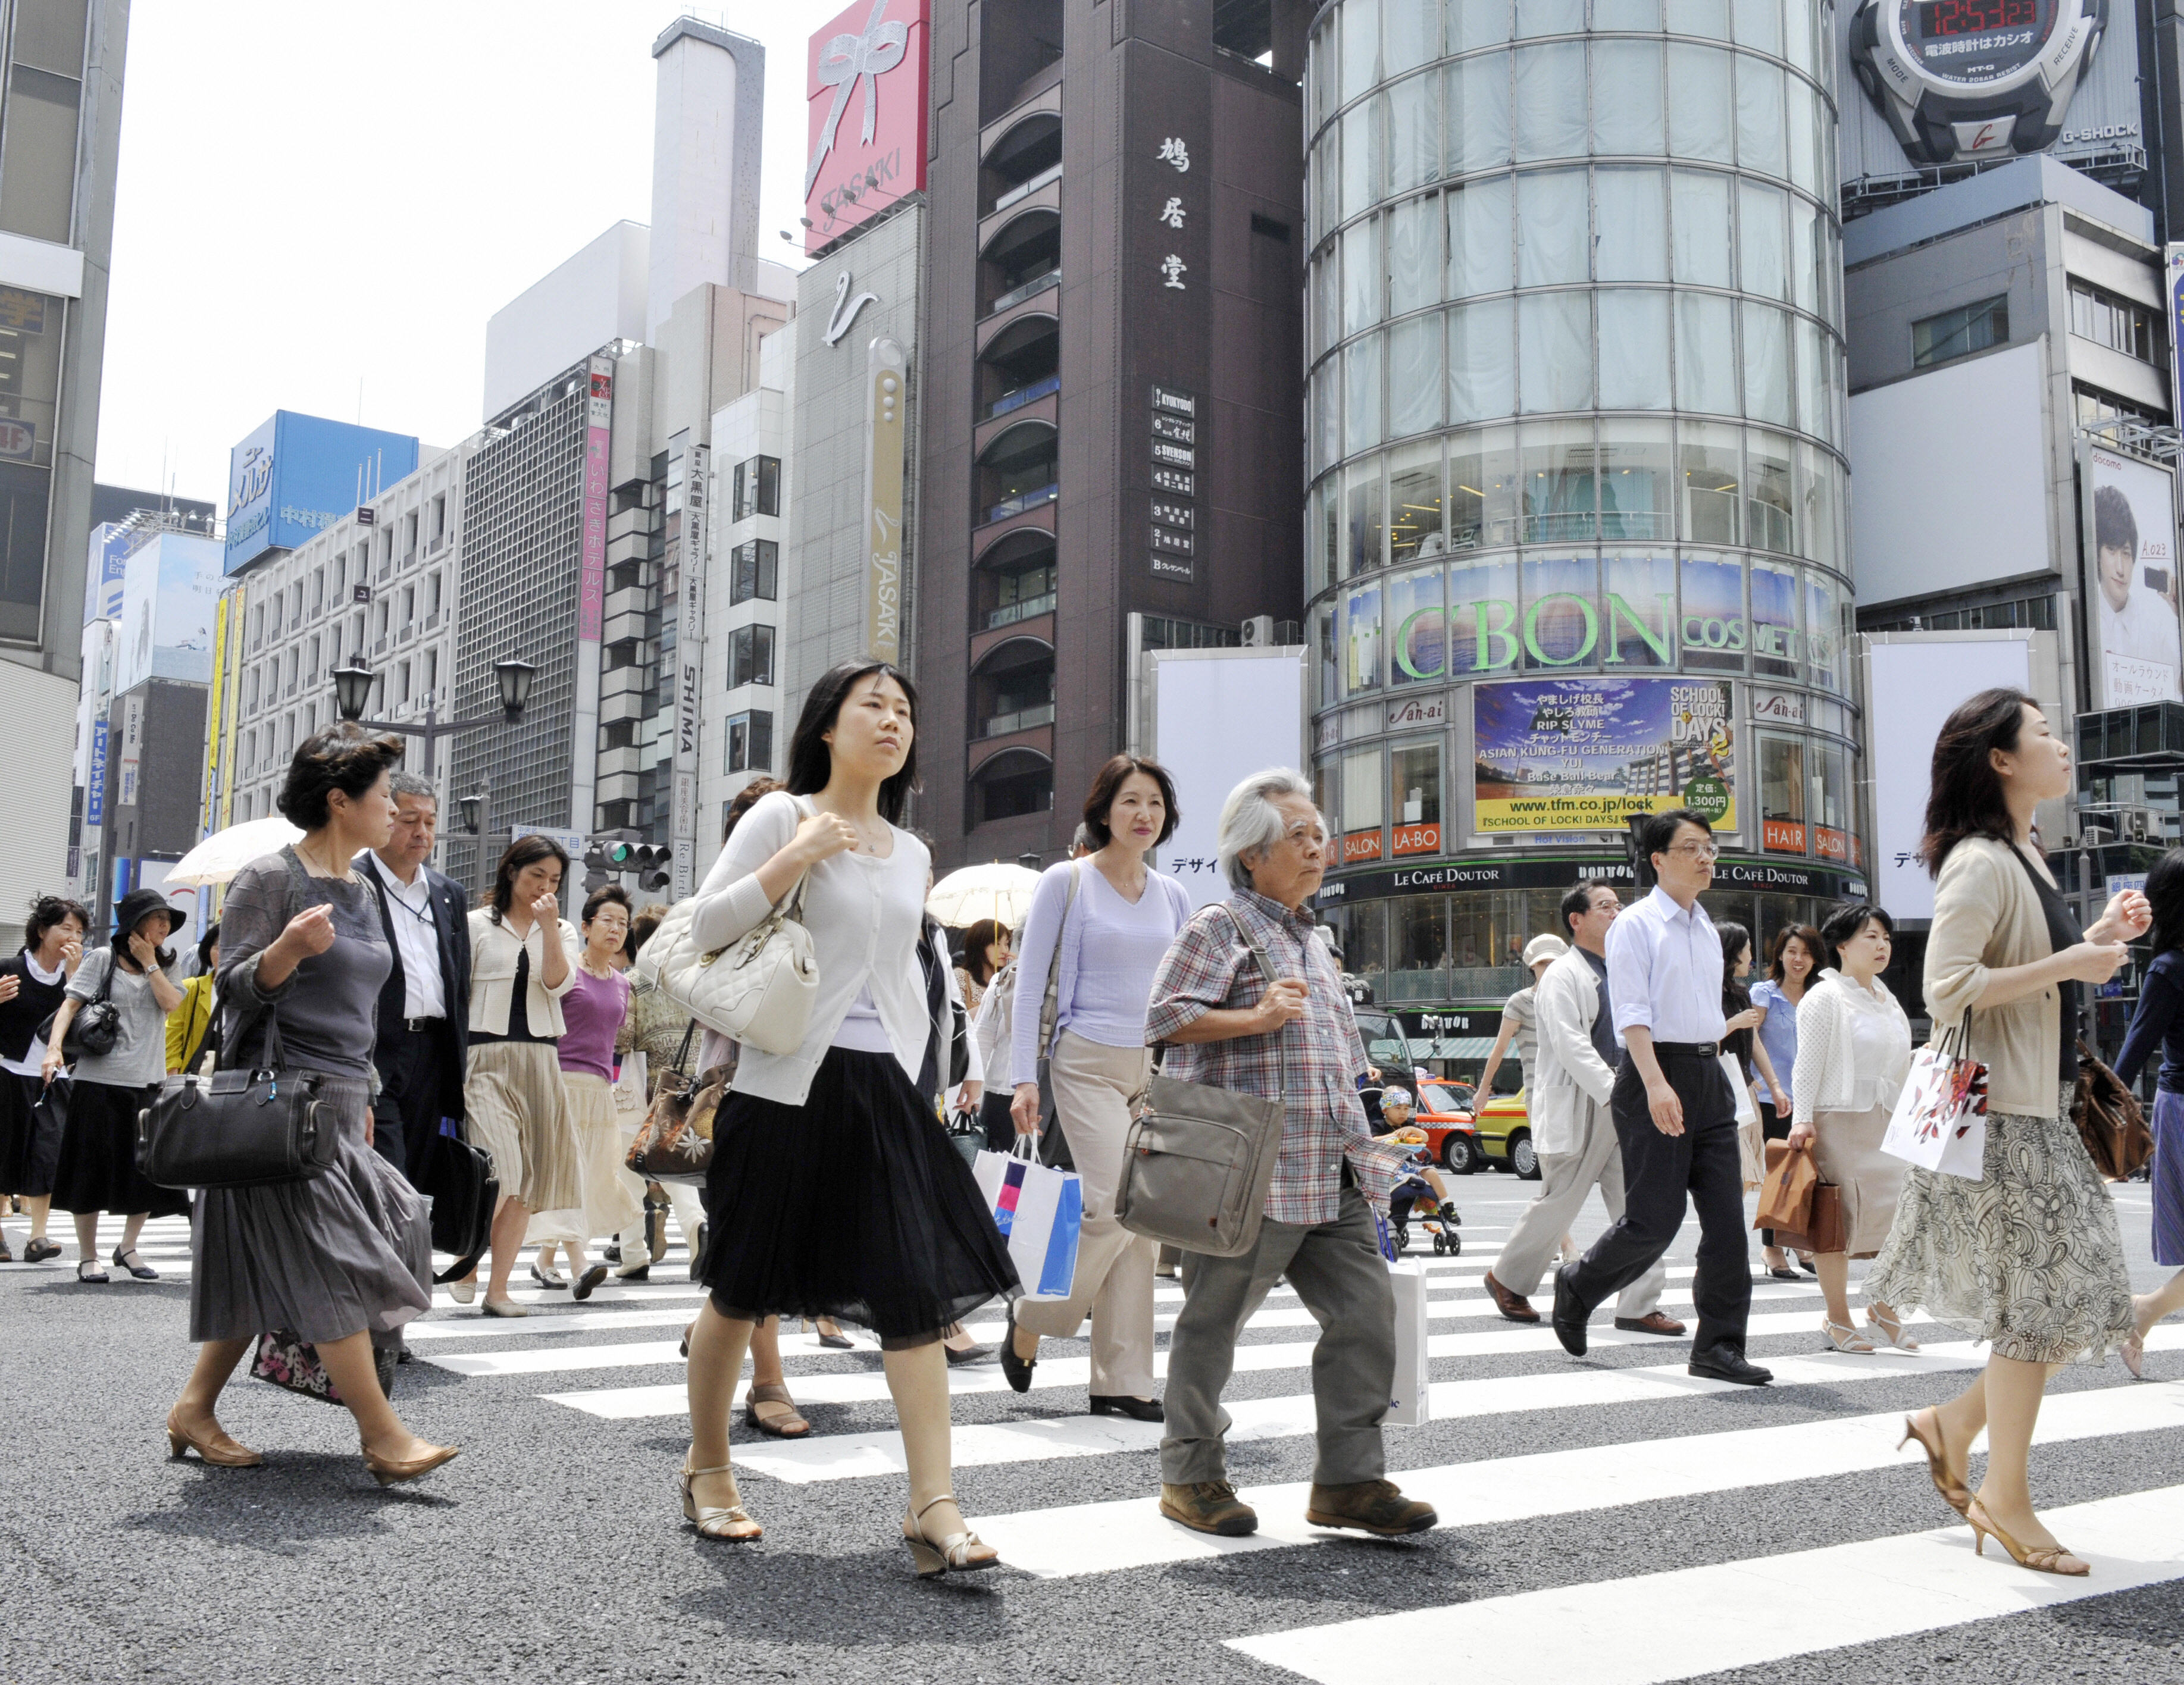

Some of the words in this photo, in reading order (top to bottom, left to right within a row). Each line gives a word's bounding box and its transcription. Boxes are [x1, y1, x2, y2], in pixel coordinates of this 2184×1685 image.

[1925, 31, 2034, 57] 電波時計はカシオ
[2054, 26, 2079, 65] RECEIVE
[1886, 58, 1909, 84] MODE
[1942, 72, 1966, 83] WATER
[1996, 62, 2022, 78] RESIST
[2063, 123, 2138, 143] G-SHOCK
[821, 147, 900, 232] TASAKI
[1156, 137, 1190, 290] 鳩居堂
[1154, 419, 1162, 429] 6
[1154, 445, 1161, 456] 5
[1162, 444, 1191, 462] SVENSON
[2093, 452, 2122, 471] docomo
[1154, 472, 1162, 483] 4
[690, 469, 703, 508] 大黒屋
[1154, 506, 1161, 516] 3
[1154, 528, 1160, 537] 2
[1153, 559, 1160, 569] B
[872, 551, 897, 649] TASAKI
[1396, 593, 1674, 679] C'BON
[2112, 660, 2168, 682] オールラウンド
[1670, 687, 1726, 703] SCHOOL
[2114, 678, 2164, 700] 動画ケータイ
[681, 664, 696, 754] SHIMA
[1537, 694, 1604, 706] やましげ校長
[1756, 696, 1803, 719] San-ai
[1389, 701, 1443, 724] San-ai
[1671, 703, 1688, 716] OF
[1690, 703, 1725, 718] LOCK!
[1537, 720, 1558, 731] RIP
[1562, 719, 1605, 730] SLYME
[1672, 716, 1727, 742] DAYS
[1529, 732, 1613, 744] チャットモンチー
[1712, 734, 1729, 757] 2
[1479, 748, 1517, 759] ASIAN
[1520, 745, 1578, 757] KUNG-FU
[1581, 744, 1666, 755] GENERATION
[91, 726, 108, 810] アートネイチャー
[1562, 757, 1583, 768] YUI
[1528, 771, 1557, 782] Base
[1561, 771, 1585, 781] Ball
[1588, 770, 1616, 781] Bear
[1510, 798, 1653, 813] www.tfm.co.jp/lock
[1534, 816, 1547, 825] OF
[1551, 815, 1582, 825] LOCK!
[1345, 837, 1379, 856] SALON
[1394, 830, 1437, 850] LA-BO
[1535, 835, 1553, 844] Hot
[1556, 835, 1585, 844] Vision
[1767, 827, 1803, 847] HAIR
[1817, 834, 1844, 853] SALON
